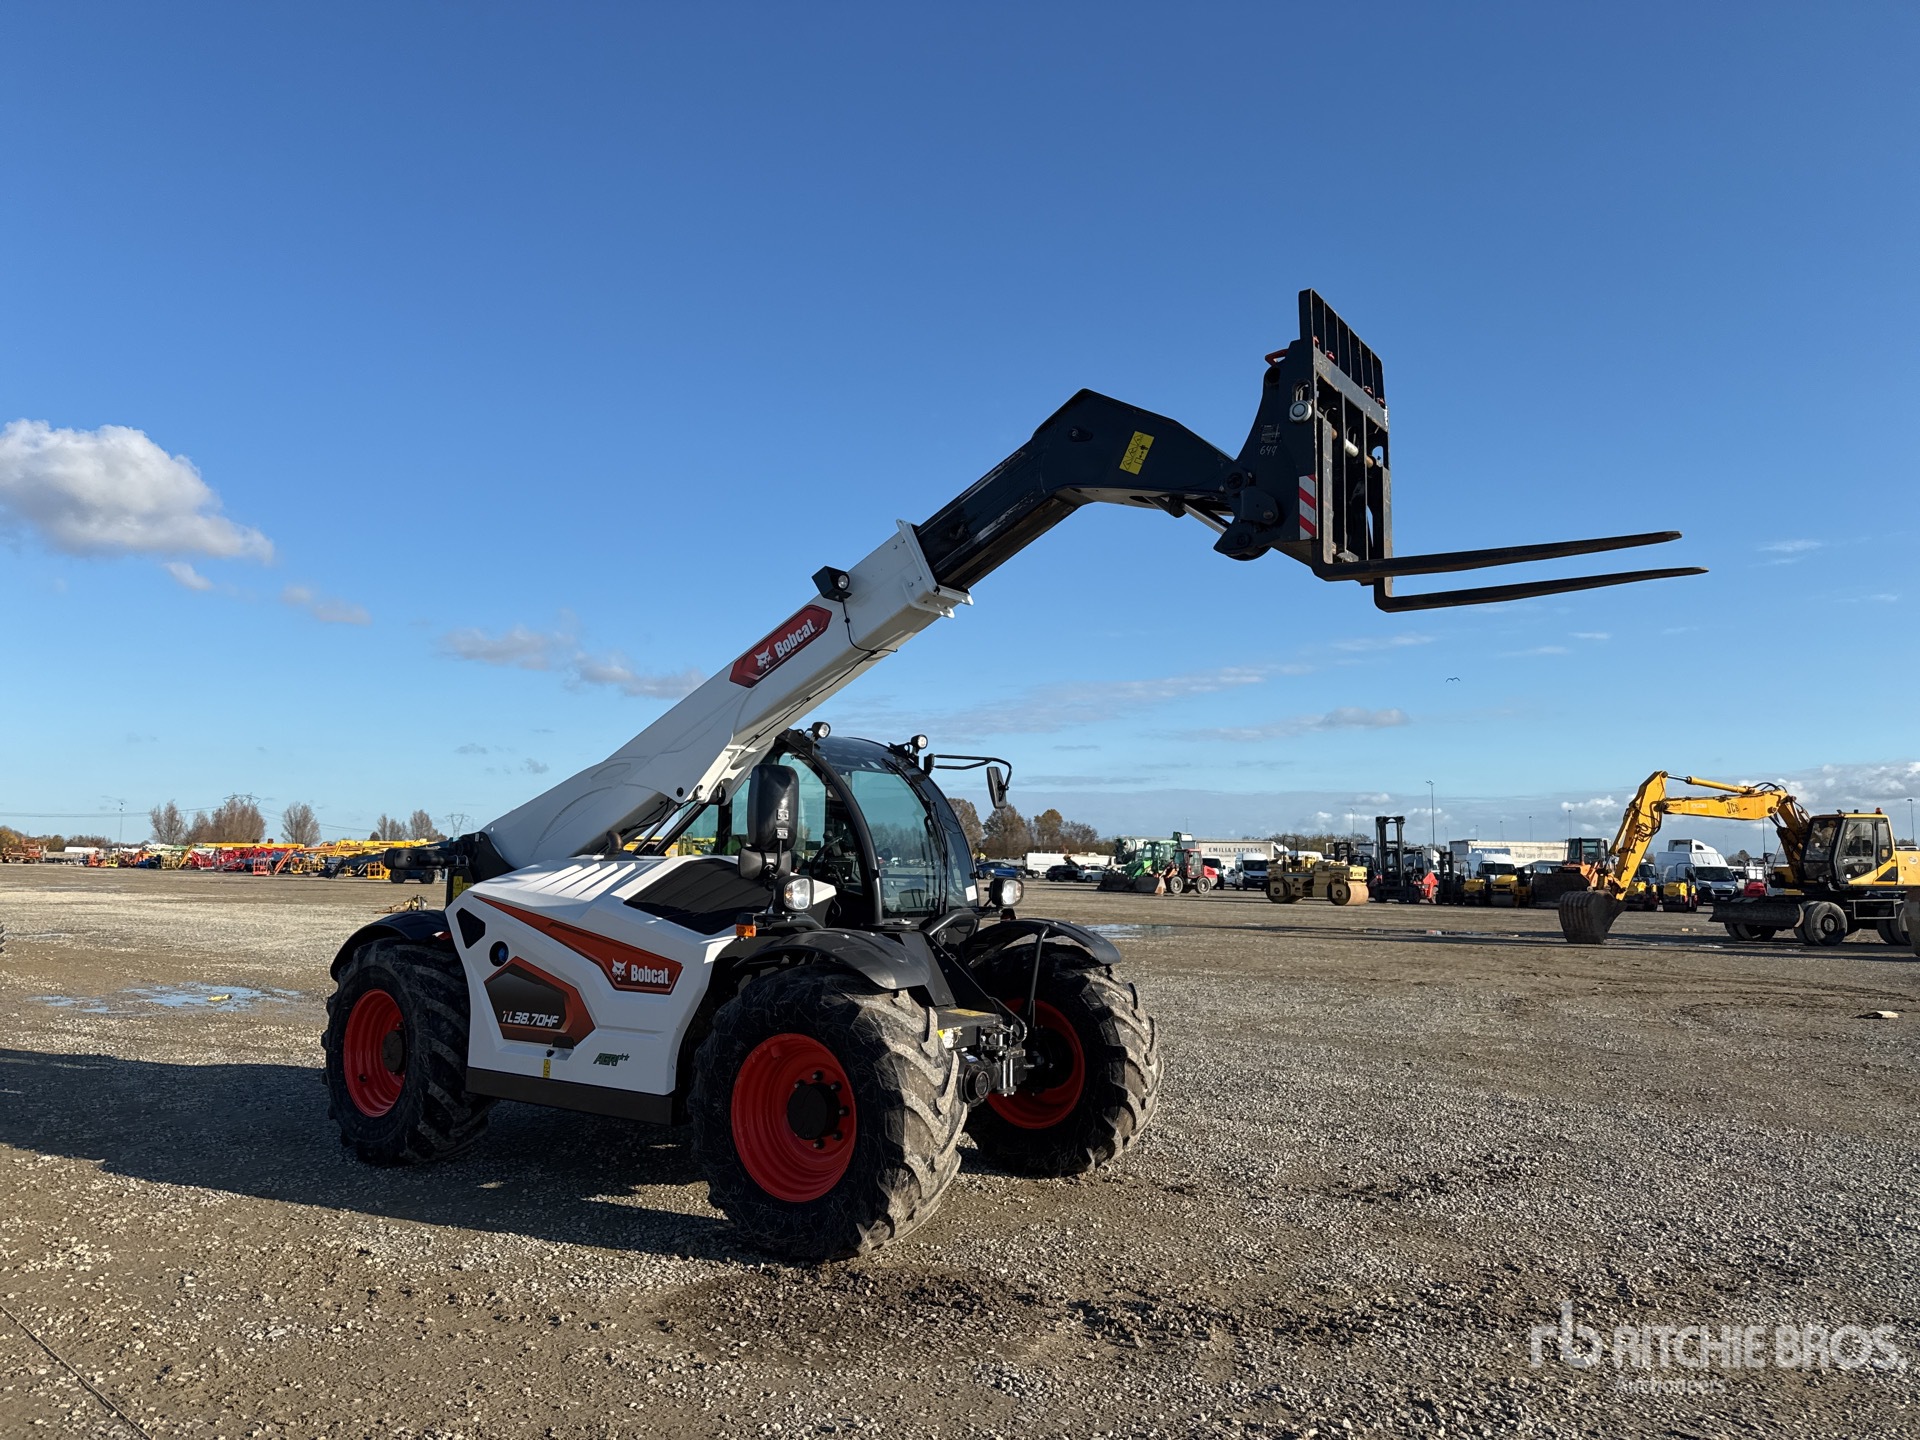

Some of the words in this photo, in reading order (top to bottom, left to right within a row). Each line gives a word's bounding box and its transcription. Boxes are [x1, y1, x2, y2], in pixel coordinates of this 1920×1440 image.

[774, 619, 816, 658] Bobcat
[1727, 801, 1740, 814] JCB
[631, 964, 669, 985] Bobcat
[502, 1010, 560, 1027] TL38.70HF
